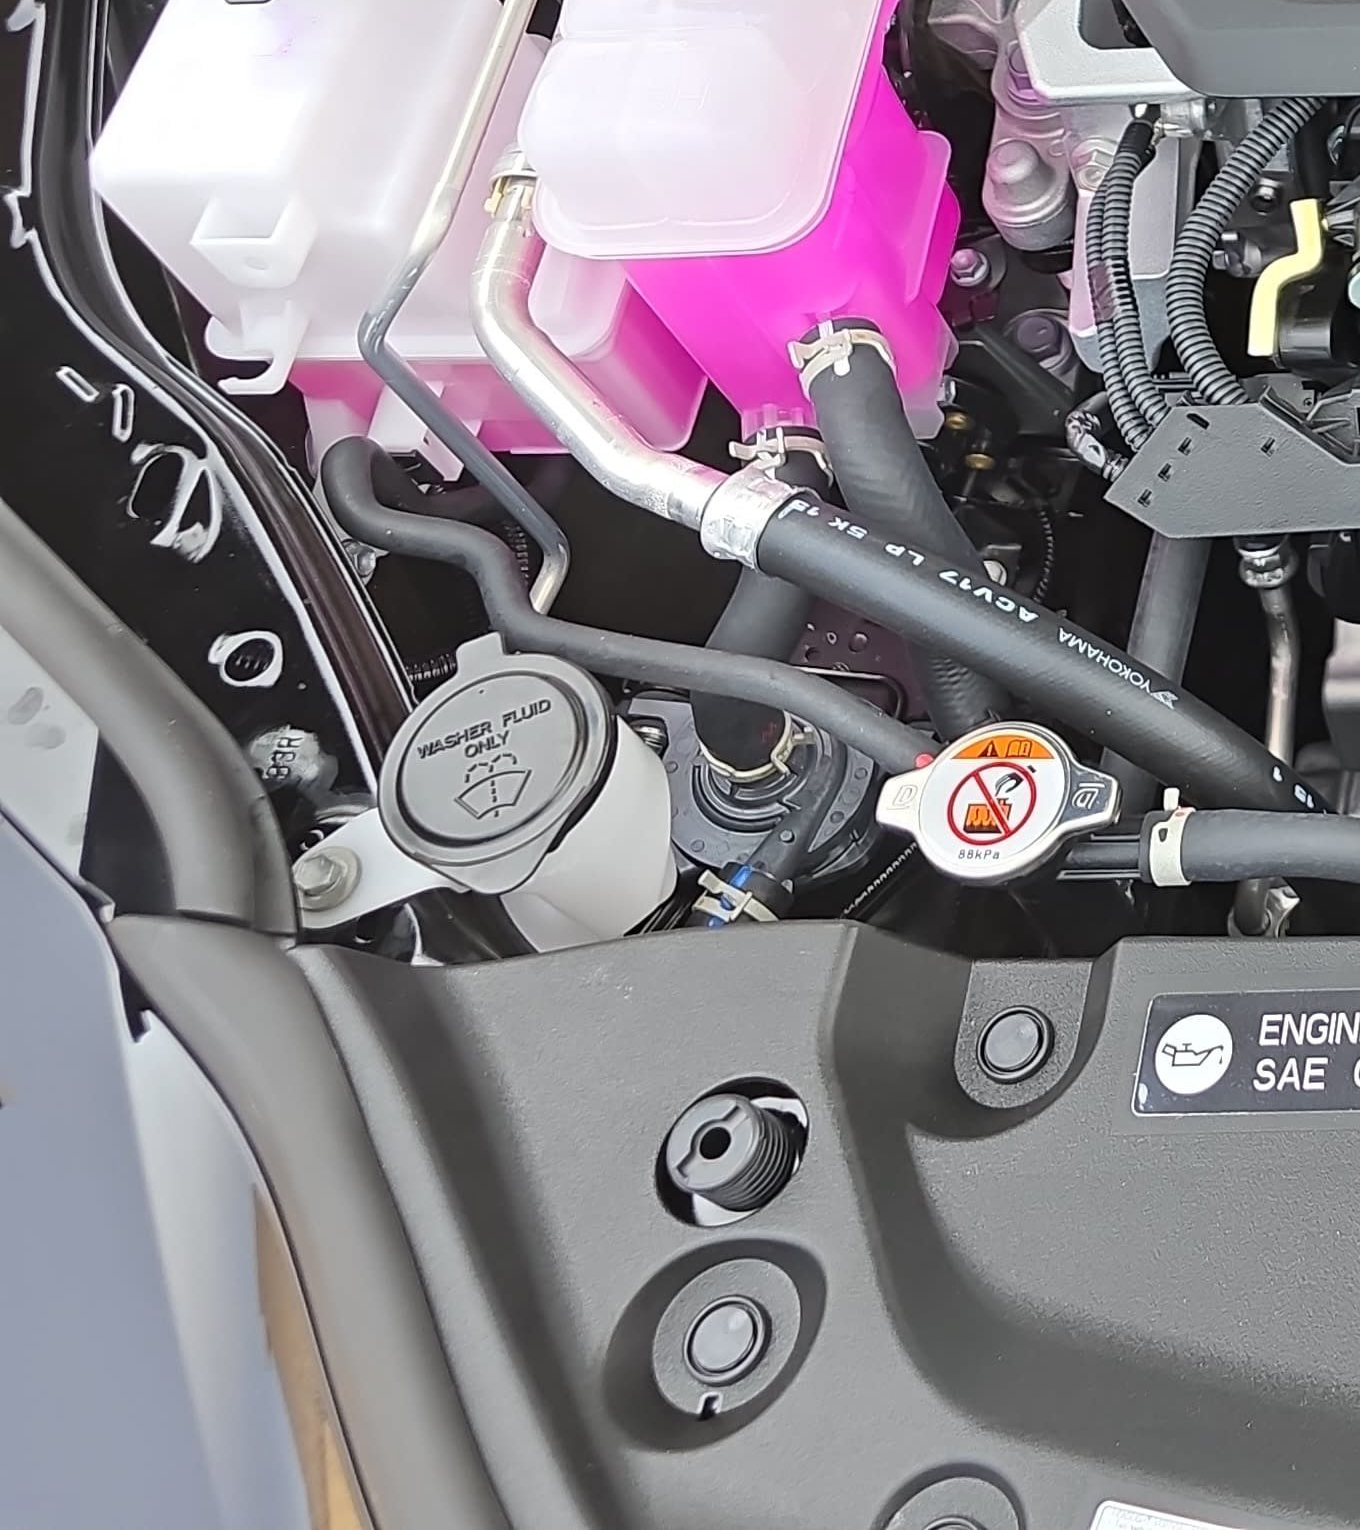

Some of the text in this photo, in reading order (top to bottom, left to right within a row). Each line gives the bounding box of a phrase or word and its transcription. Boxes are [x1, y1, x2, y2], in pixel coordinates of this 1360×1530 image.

[827, 516, 869, 540] 5K
[884, 542, 927, 567] LP
[938, 569, 1040, 623] ACV17
[1057, 627, 1152, 693] YOKOHAMA
[416, 698, 553, 761] WASHER FLUID
[463, 730, 512, 759] ONLY
[958, 848, 1001, 861] 88kPa
[1252, 1055, 1327, 1092] SAE
